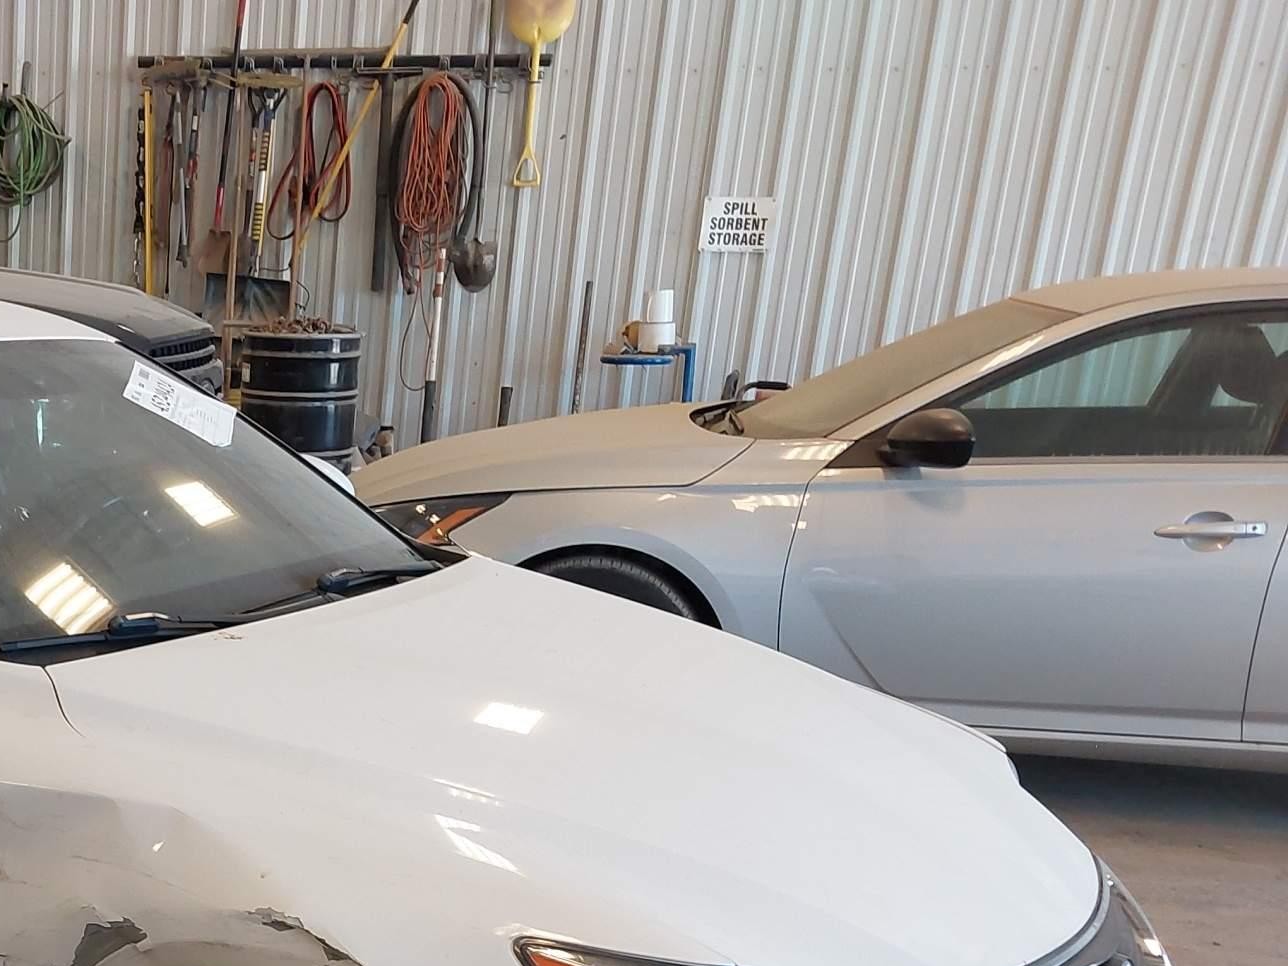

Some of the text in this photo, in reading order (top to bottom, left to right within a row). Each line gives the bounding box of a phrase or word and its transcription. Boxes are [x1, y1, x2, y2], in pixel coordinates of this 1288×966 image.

[723, 201, 758, 216] SPILL
[709, 216, 769, 232] SORBENT
[707, 232, 766, 247] STORAGE
